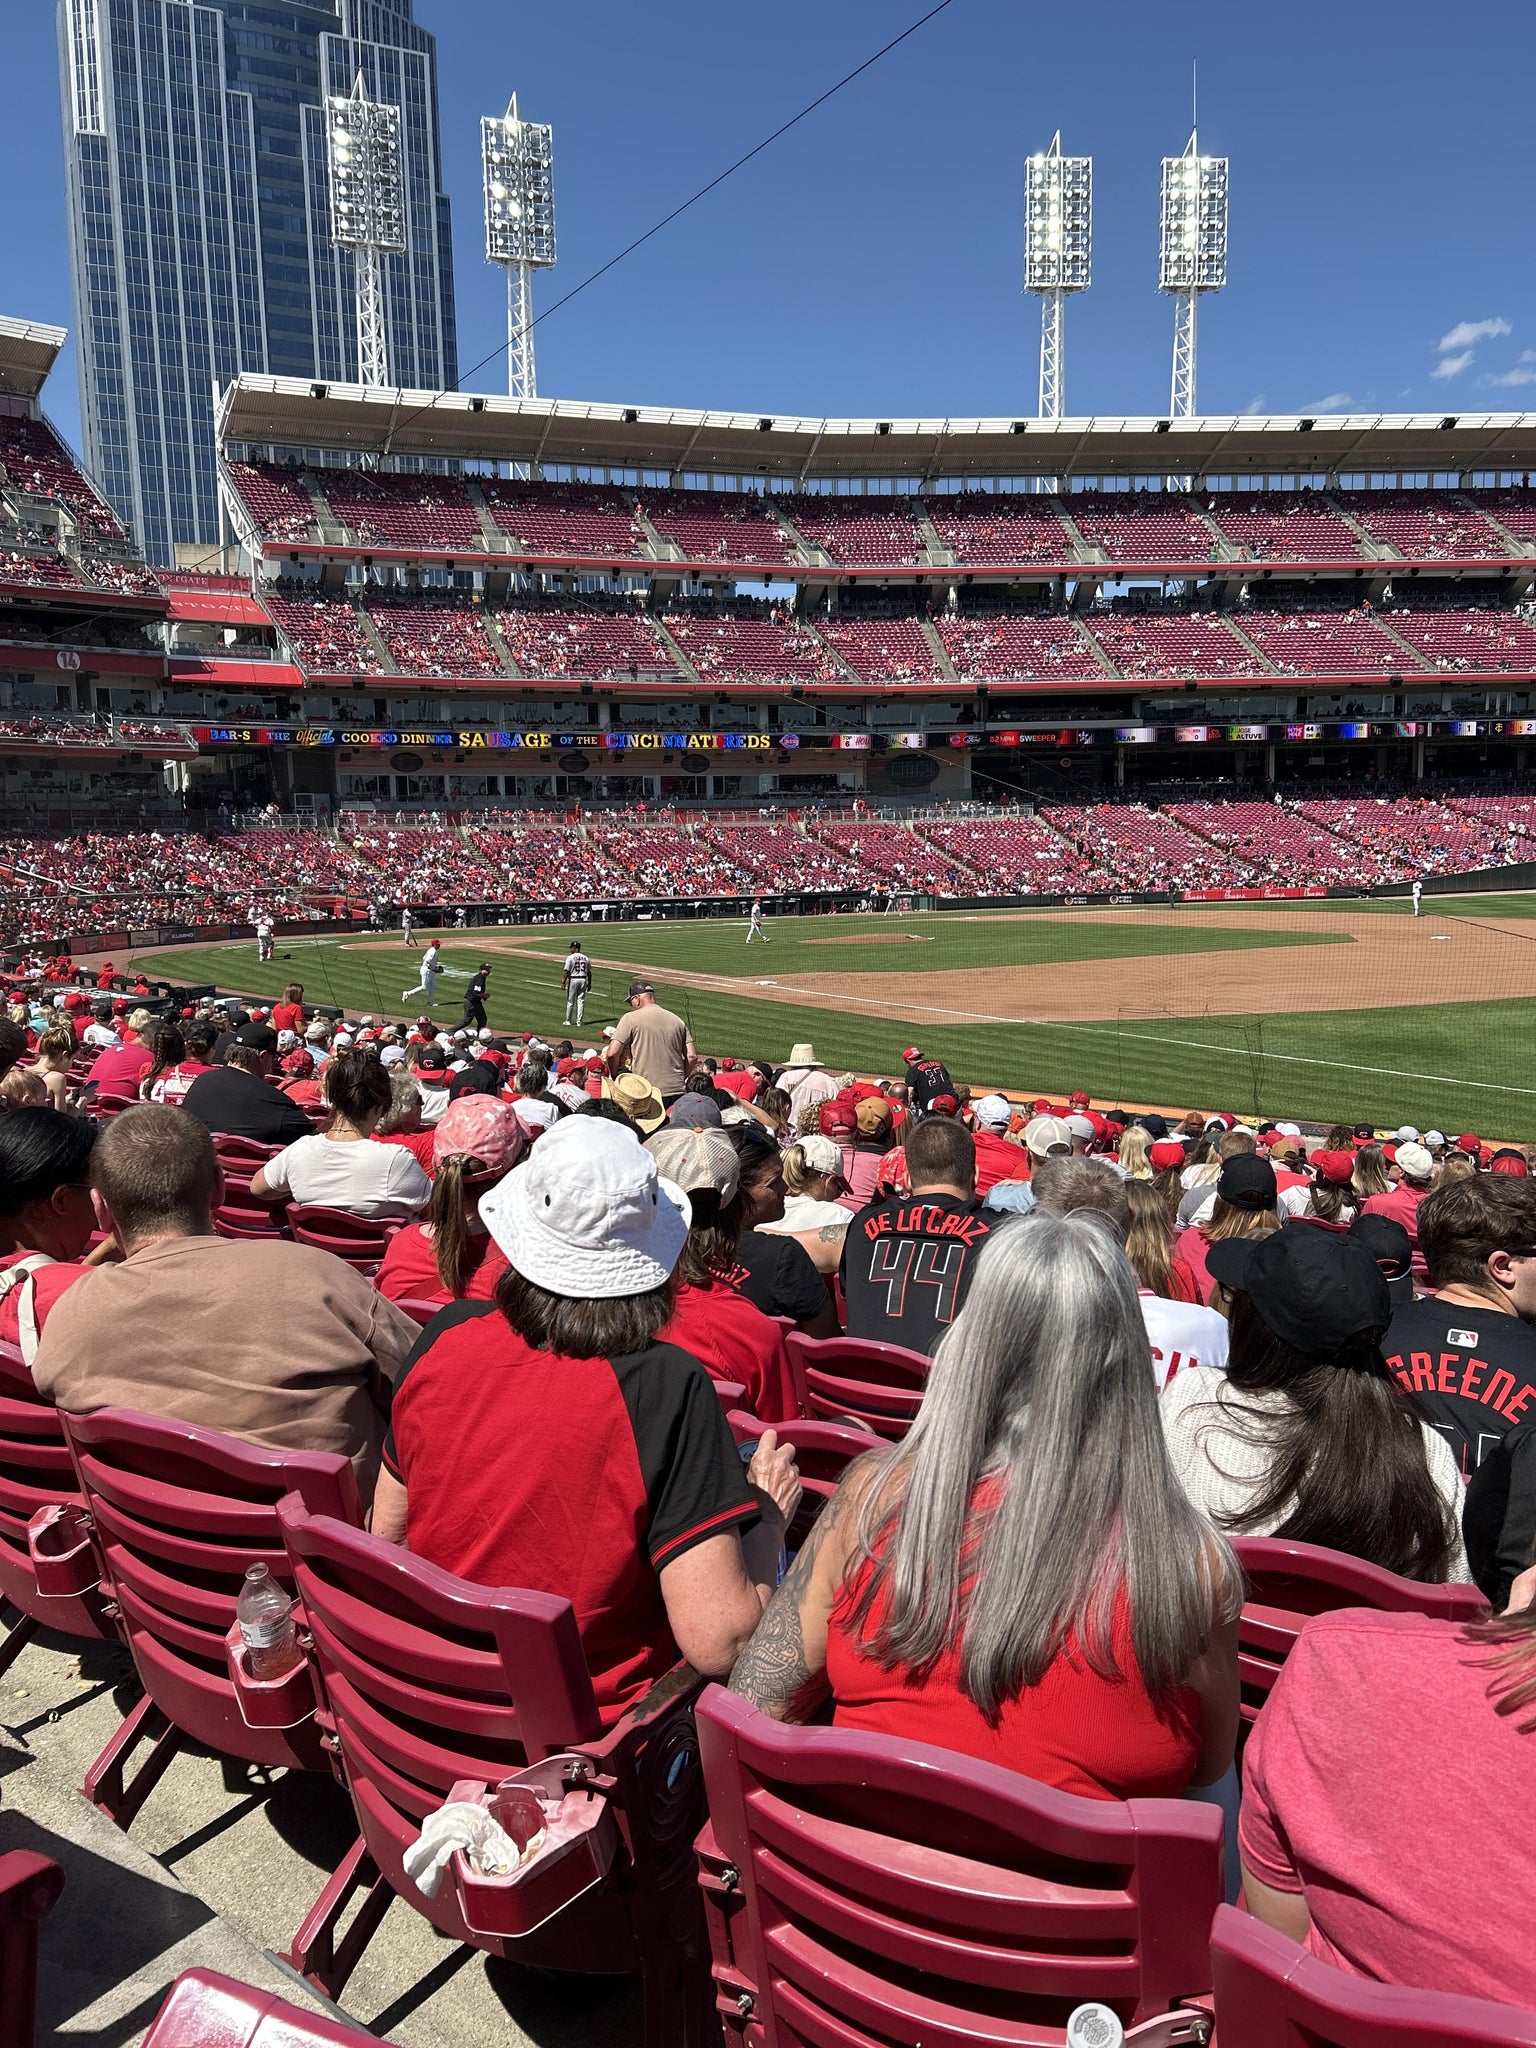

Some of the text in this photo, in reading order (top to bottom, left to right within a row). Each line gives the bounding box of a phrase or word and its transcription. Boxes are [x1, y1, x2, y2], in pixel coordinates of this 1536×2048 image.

[60, 652, 78, 669] 14
[1526, 723, 1533, 733] 2
[210, 730, 771, 749] BAR-S THE Official COOKED DINNER SAUSAGE OF THE CINCINNATI REDS
[902, 737, 909, 745] 4
[1019, 735, 1056, 743] SWEEPER
[171, 932, 194, 940] KUMHO
[575, 962, 586, 972] 23
[924, 1067, 945, 1086] 37
[863, 1206, 990, 1247] DE LA CRUZ
[868, 1239, 967, 1324] 44
[1385, 1351, 1536, 1425] GREENE
